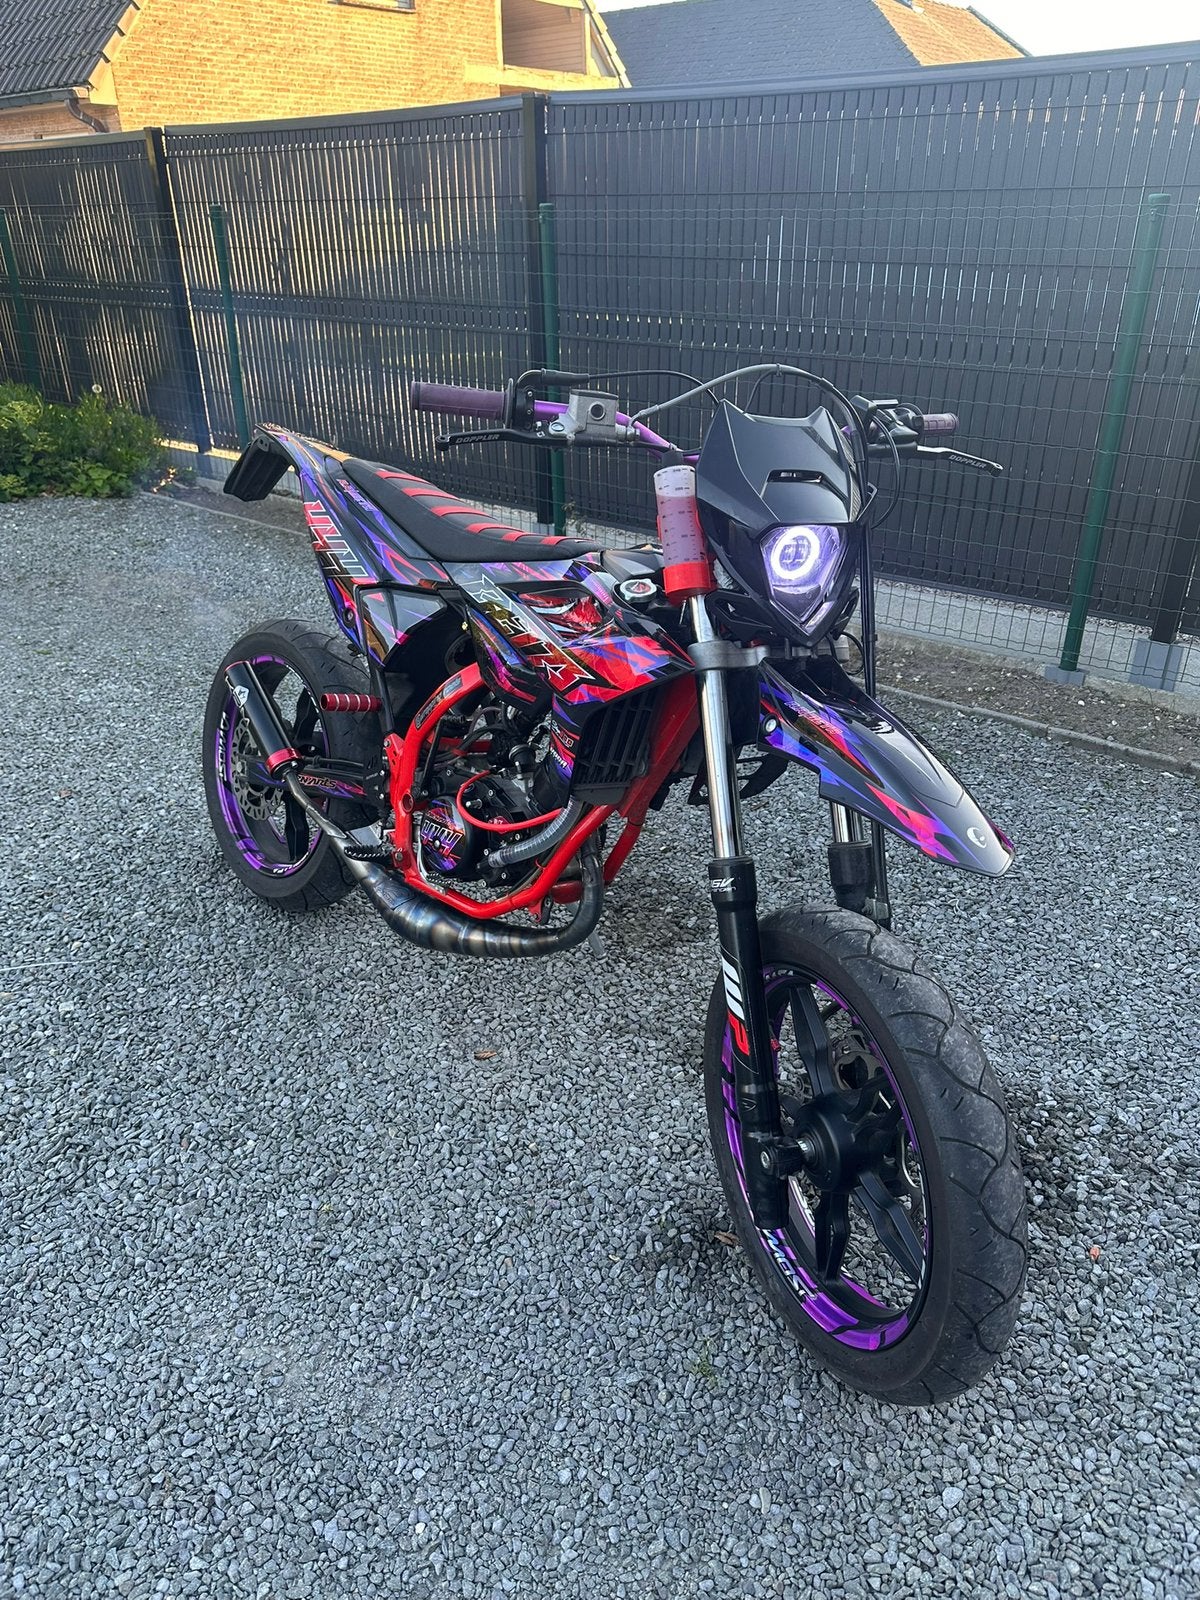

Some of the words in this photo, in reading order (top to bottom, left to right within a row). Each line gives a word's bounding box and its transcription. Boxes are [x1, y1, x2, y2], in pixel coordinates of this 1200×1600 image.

[455, 434, 500, 444] DOPPLER
[949, 454, 987, 469] DOPPLER
[721, 955, 750, 1056] WP
[761, 1228, 818, 1301] MOST
